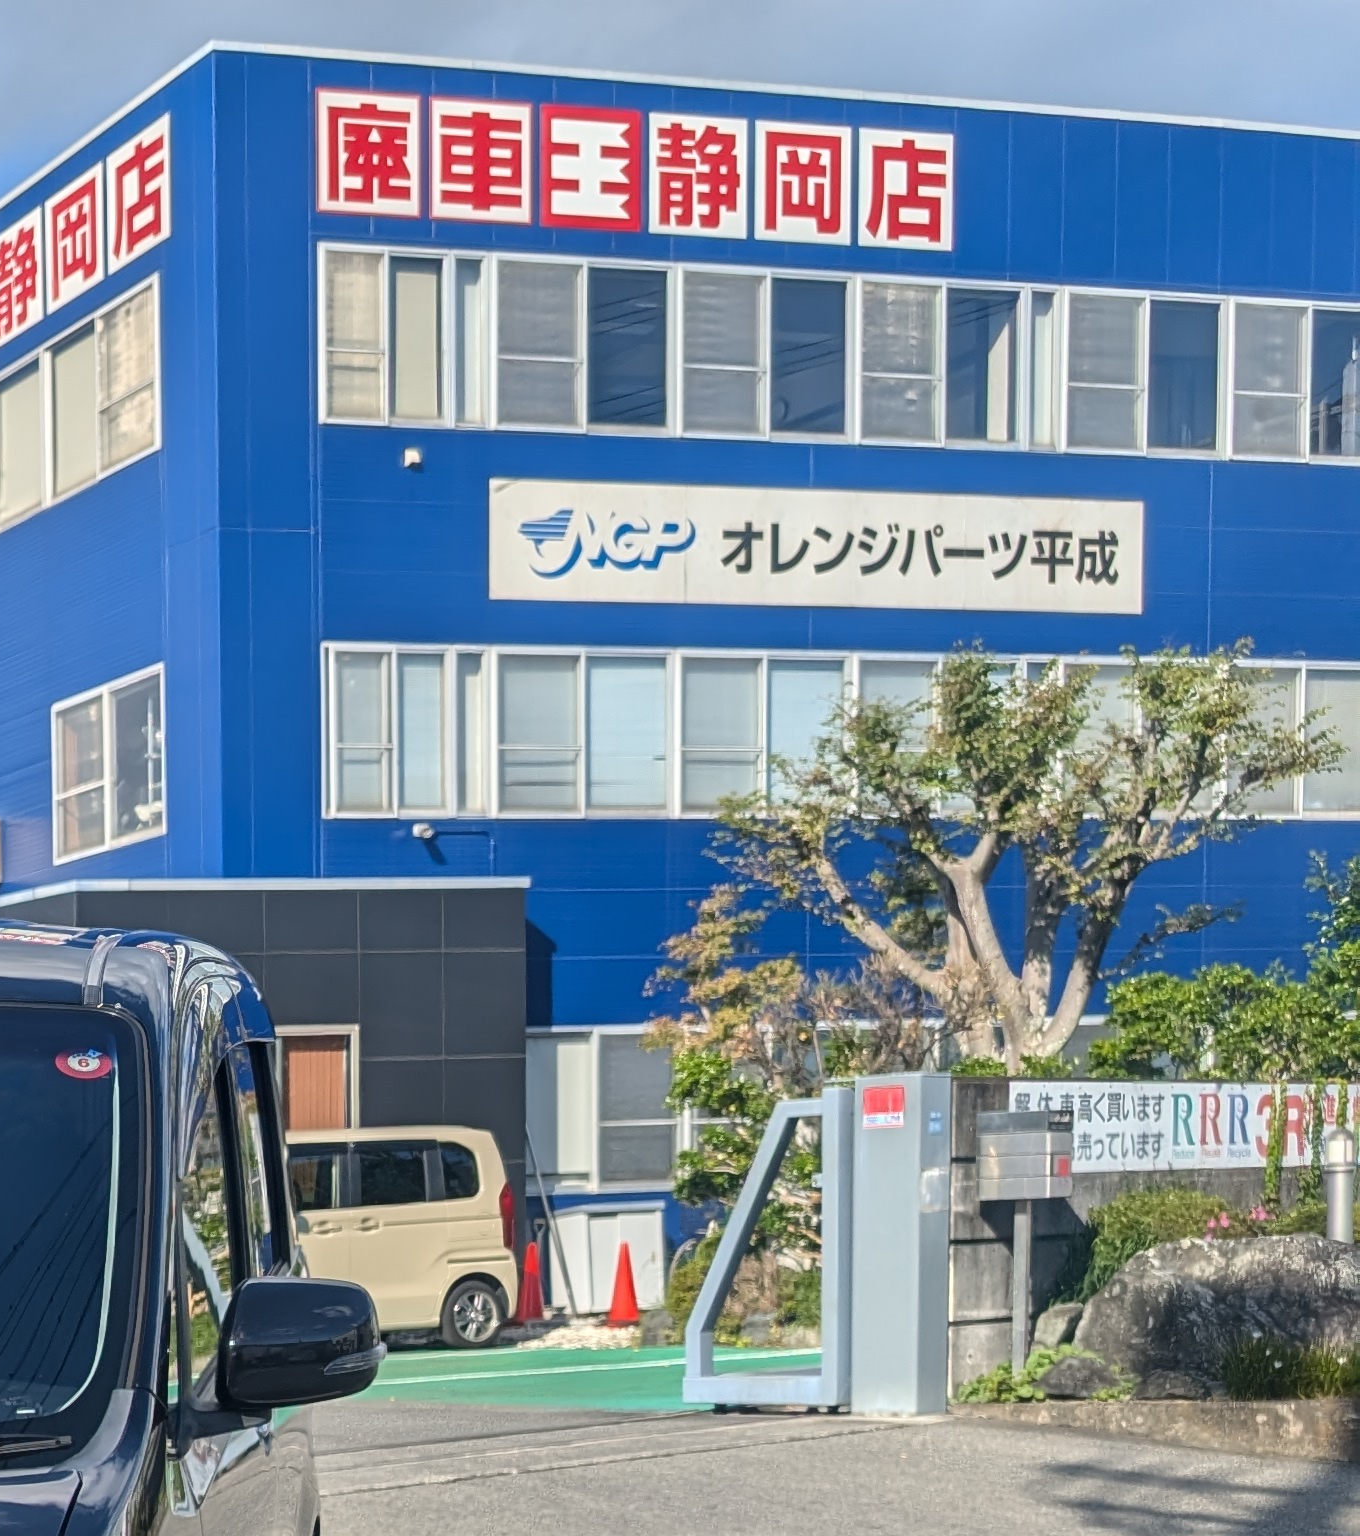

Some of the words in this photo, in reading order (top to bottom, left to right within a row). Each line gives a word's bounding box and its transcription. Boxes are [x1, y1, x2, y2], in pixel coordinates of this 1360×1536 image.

[721, 520, 1120, 587] オレンジパーツ平成
[1072, 1131, 1165, 1161] 売っています
